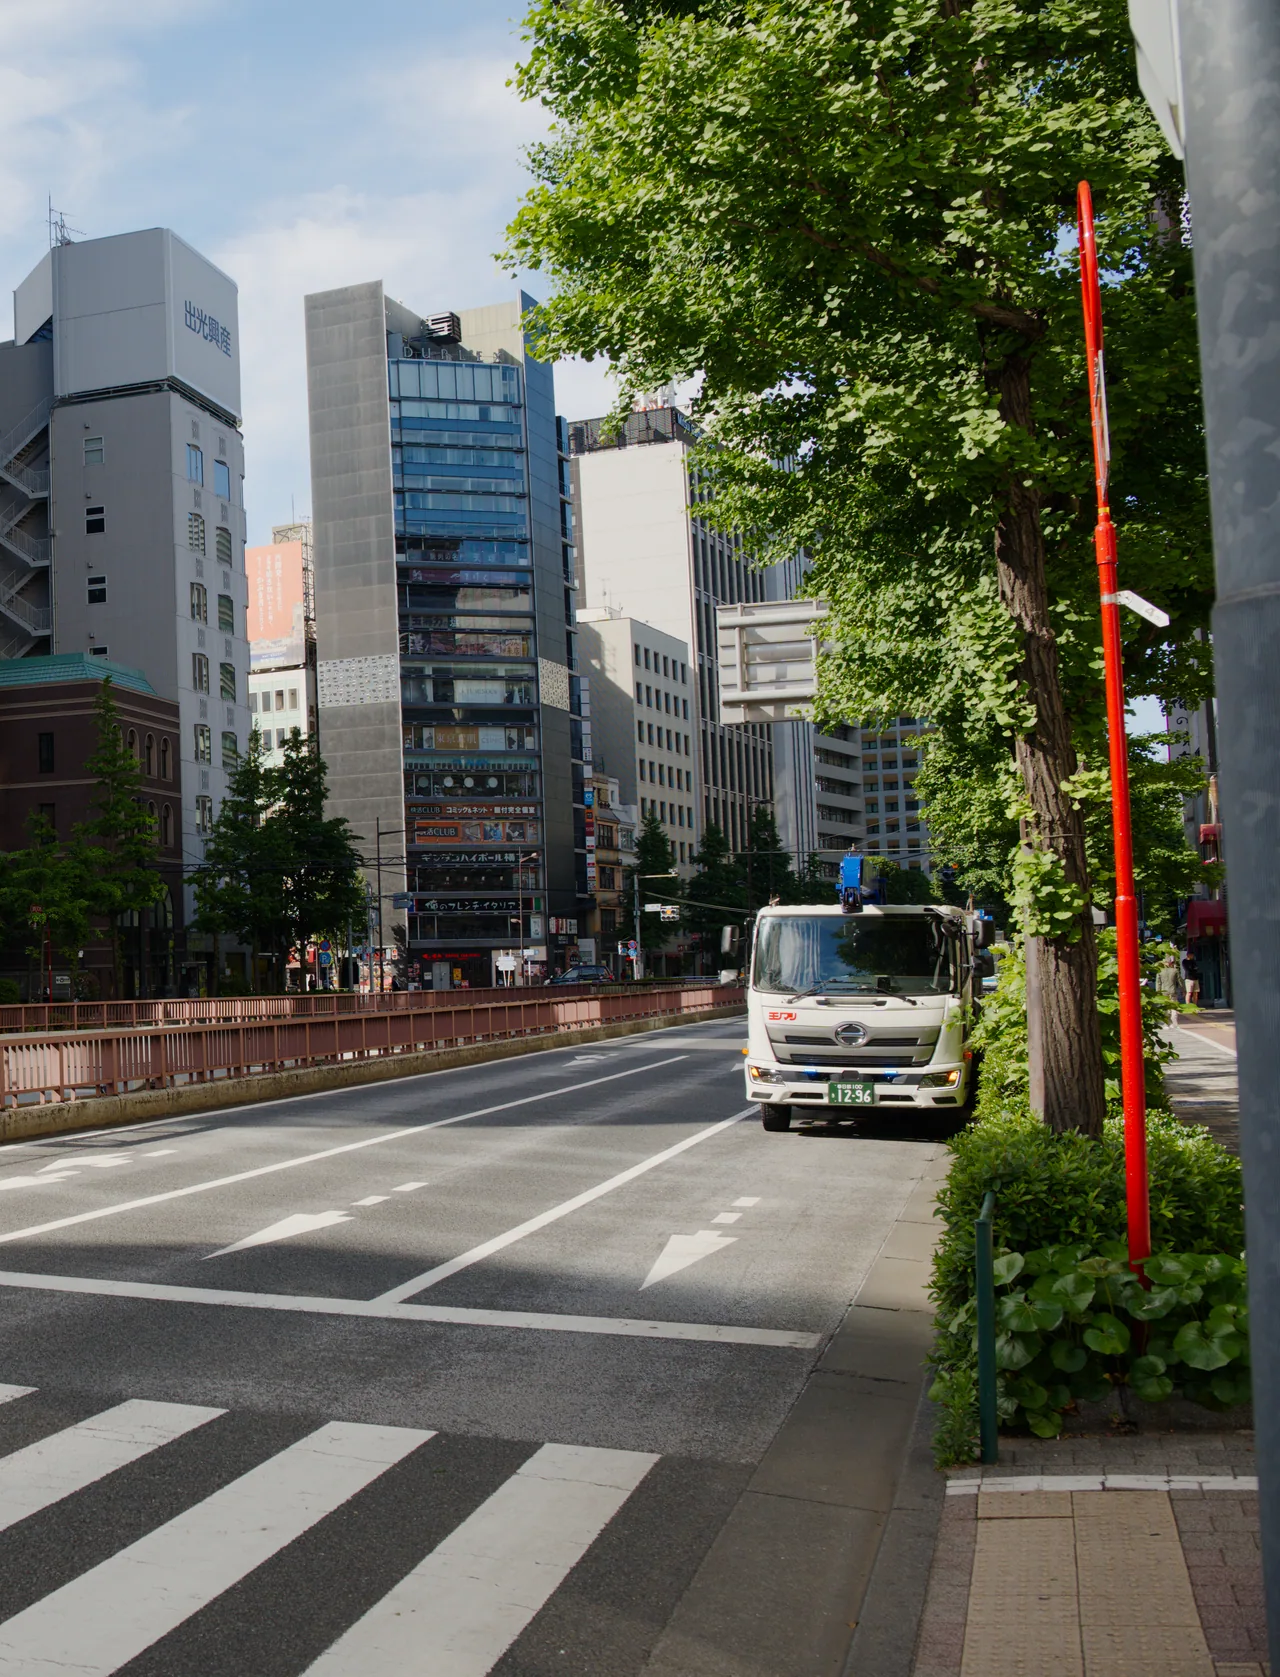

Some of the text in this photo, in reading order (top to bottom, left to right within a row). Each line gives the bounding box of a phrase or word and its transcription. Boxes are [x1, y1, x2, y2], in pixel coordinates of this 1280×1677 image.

[184, 300, 231, 358] 出光興産
[838, 1090, 871, 1102] 12-96
